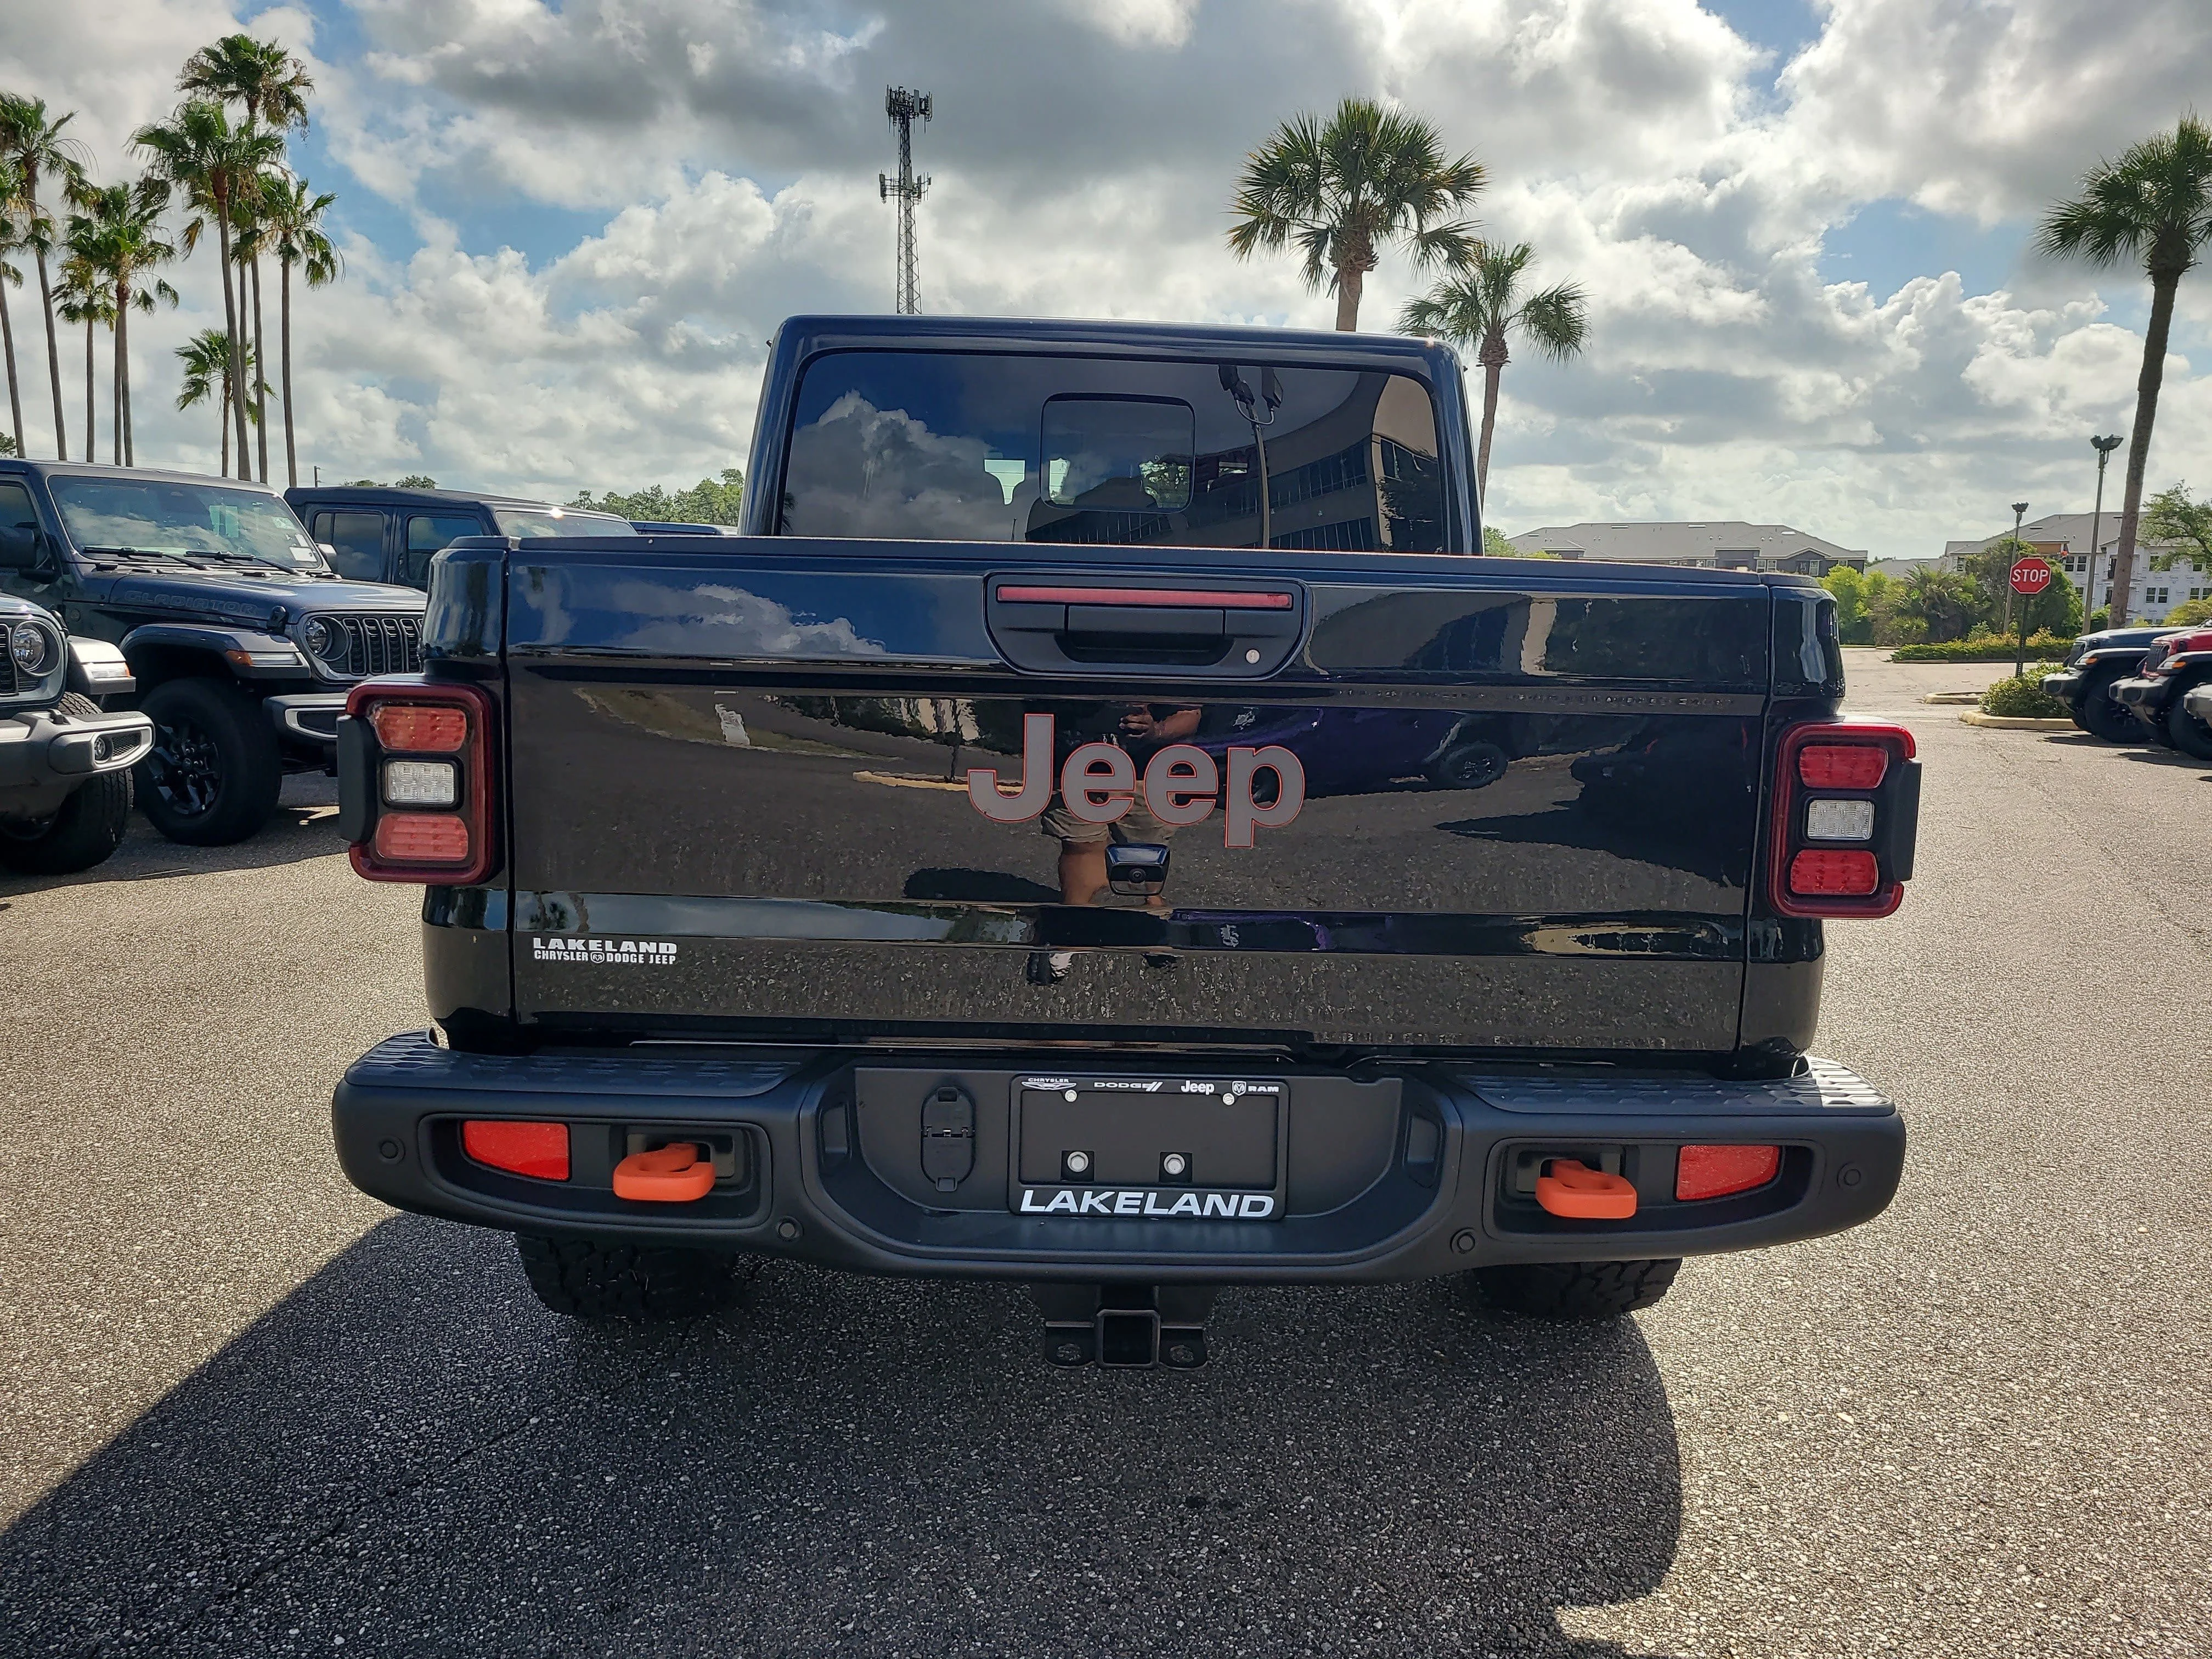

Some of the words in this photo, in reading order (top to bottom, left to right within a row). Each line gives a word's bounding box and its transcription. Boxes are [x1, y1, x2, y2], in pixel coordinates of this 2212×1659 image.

[2012, 569, 2049, 583] STOP
[125, 590, 259, 615] GLADIATOR
[967, 713, 1305, 848] Jeep
[533, 938, 678, 953] LAKELAND
[534, 950, 589, 961] CHRYSLER
[607, 953, 645, 963] DODGE
[649, 955, 676, 964] JEEP
[1181, 1080, 1215, 1094] Jeep
[1020, 1189, 1274, 1217] LAKELAND
